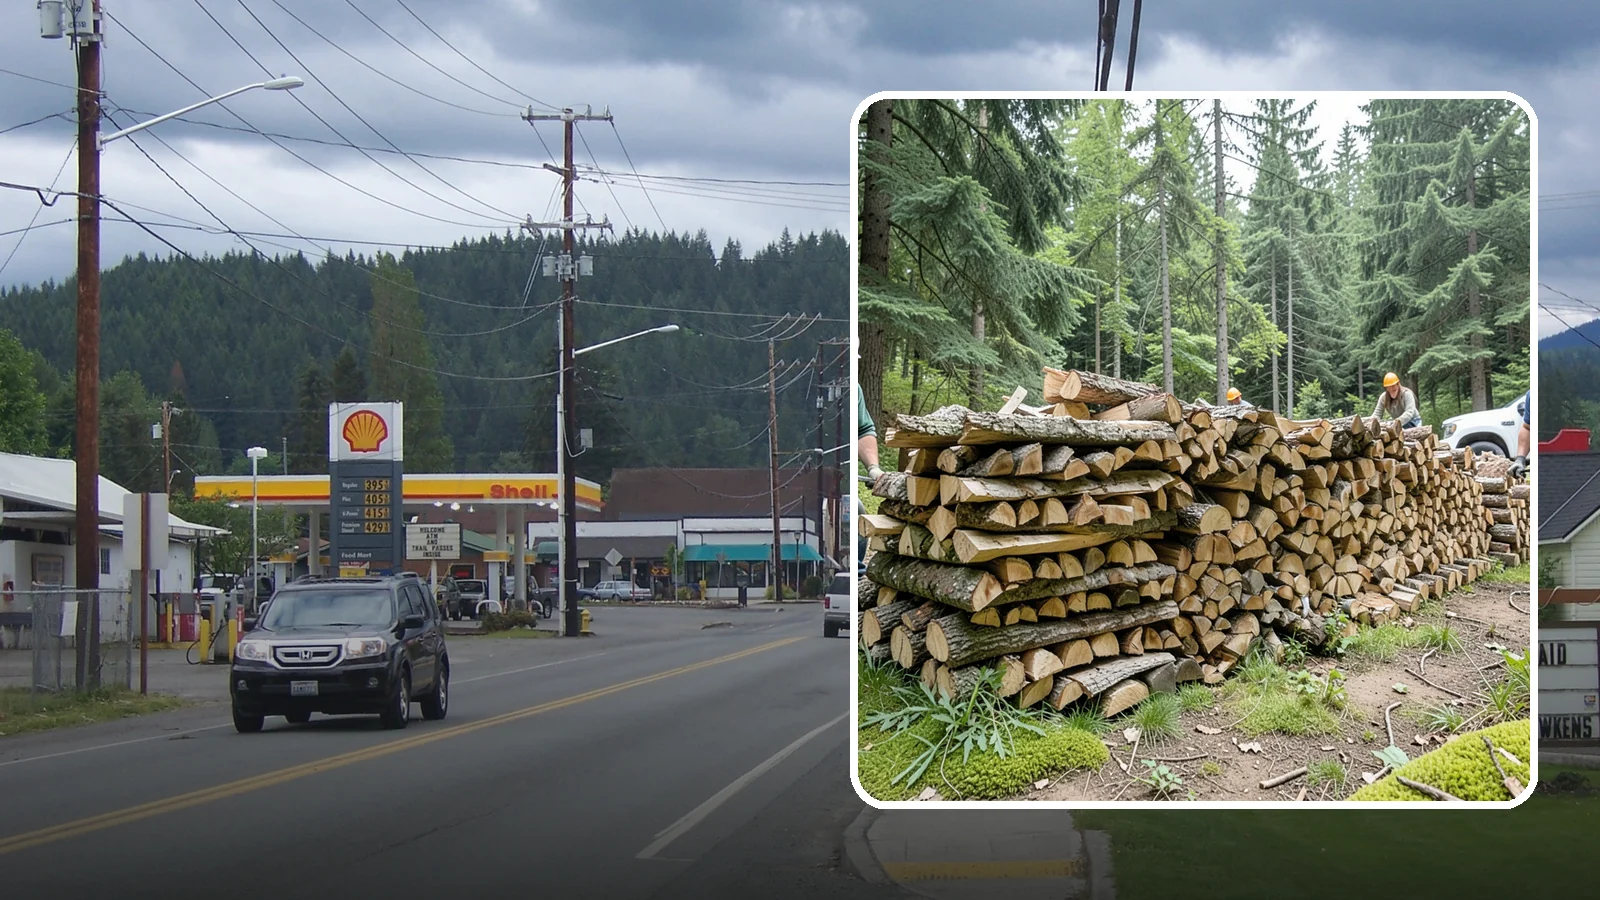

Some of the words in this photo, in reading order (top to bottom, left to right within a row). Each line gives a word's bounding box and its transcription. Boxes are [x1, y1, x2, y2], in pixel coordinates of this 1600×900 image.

[366, 480, 384, 490] 395
[490, 484, 547, 499] Shell
[366, 494, 384, 504] 405
[366, 508, 384, 518] 415
[366, 522, 384, 533] 429
